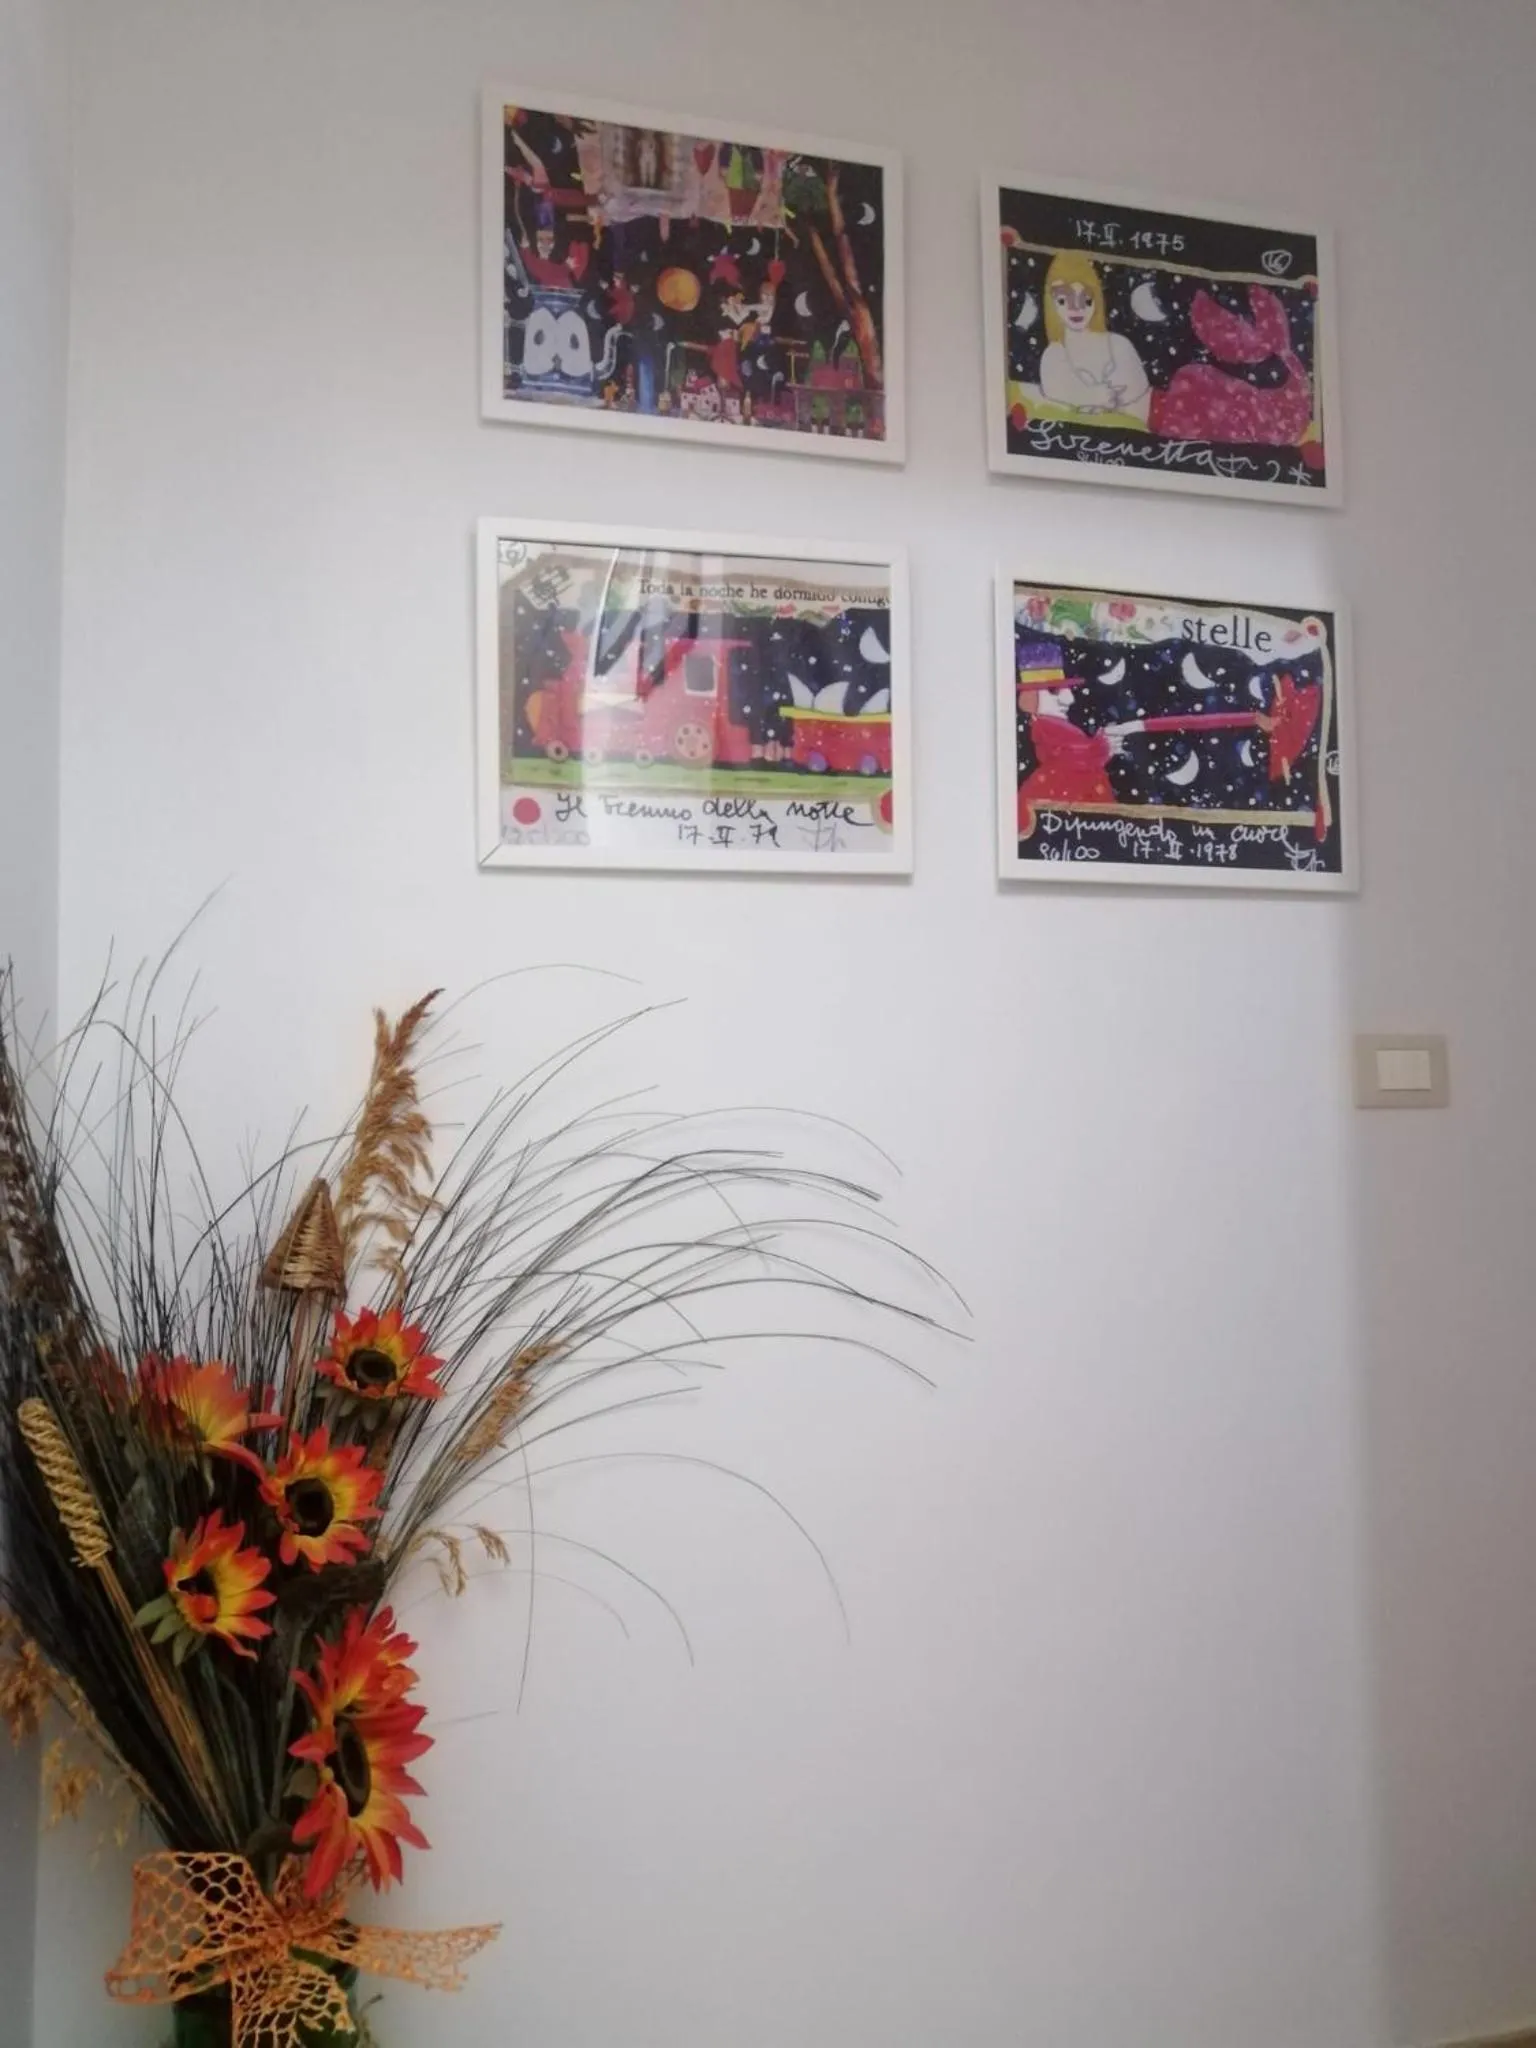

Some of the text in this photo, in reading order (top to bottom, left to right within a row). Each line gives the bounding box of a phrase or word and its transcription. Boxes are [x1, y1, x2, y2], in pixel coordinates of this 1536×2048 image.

[680, 579, 694, 598] la
[699, 579, 745, 599] noche
[750, 582, 769, 600] he
[1182, 614, 1272, 653] stelle
